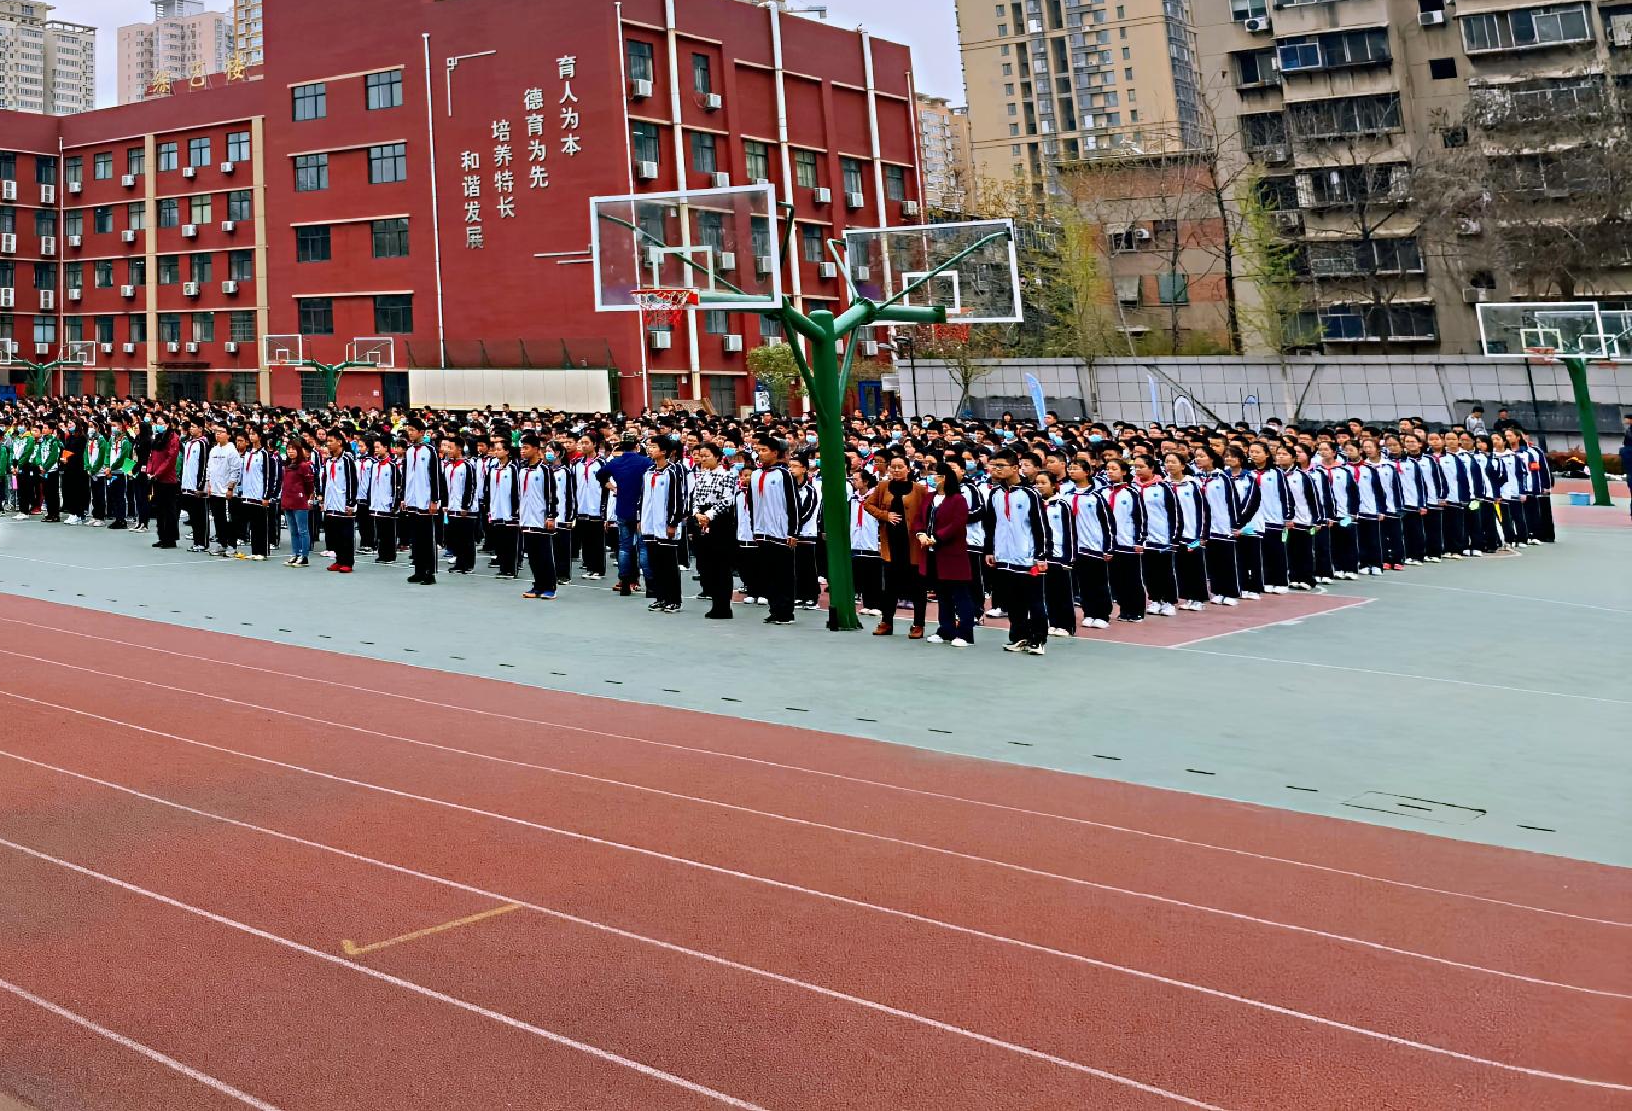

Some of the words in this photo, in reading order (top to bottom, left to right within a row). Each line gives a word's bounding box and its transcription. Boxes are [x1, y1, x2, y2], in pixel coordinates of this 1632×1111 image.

[524, 88, 549, 189] 德育为先
[556, 55, 581, 156] 育人为本
[461, 150, 484, 249] 和谐发展
[491, 120, 515, 218] 培养特长
